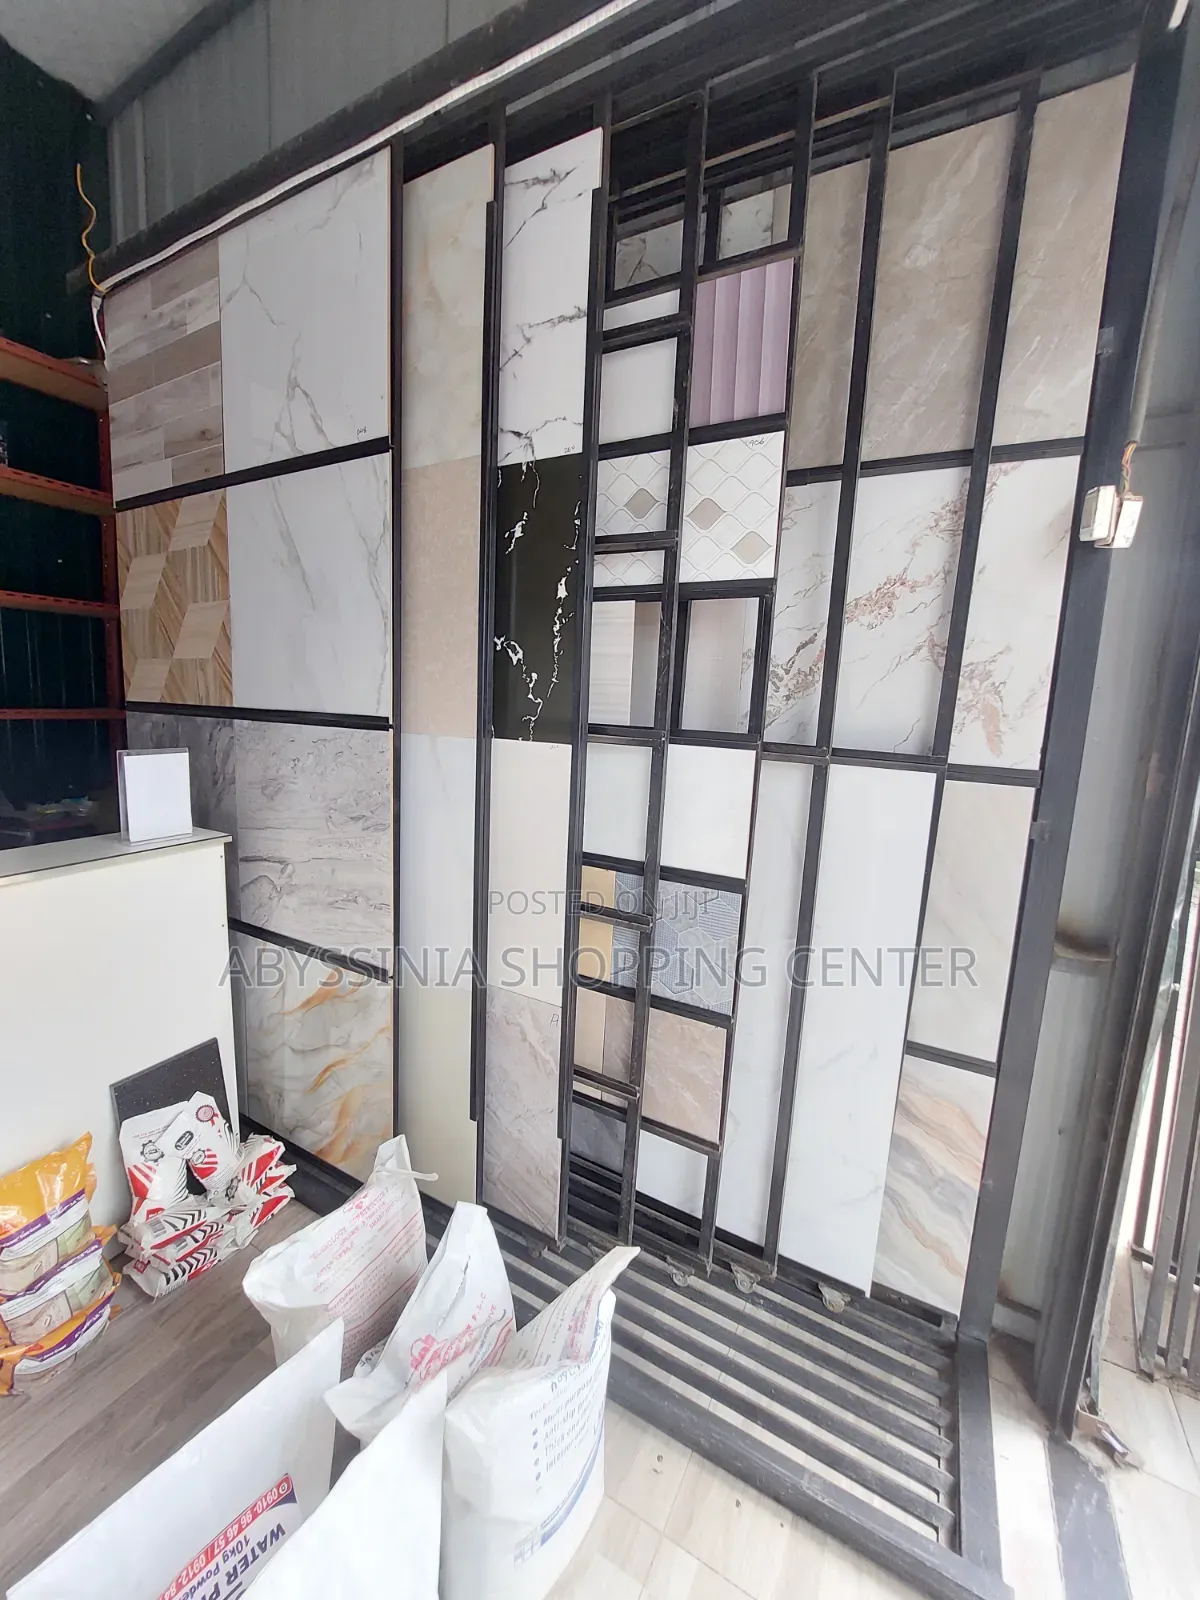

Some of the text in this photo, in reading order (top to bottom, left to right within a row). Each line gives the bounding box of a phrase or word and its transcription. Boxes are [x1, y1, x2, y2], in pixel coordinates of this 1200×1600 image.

[240, 1511, 253, 1529] 96
[226, 1523, 239, 1542] 46
[213, 1535, 226, 1556] 57
[225, 1523, 286, 1587] WATER
[181, 1535, 251, 1600] 10kg Powde
